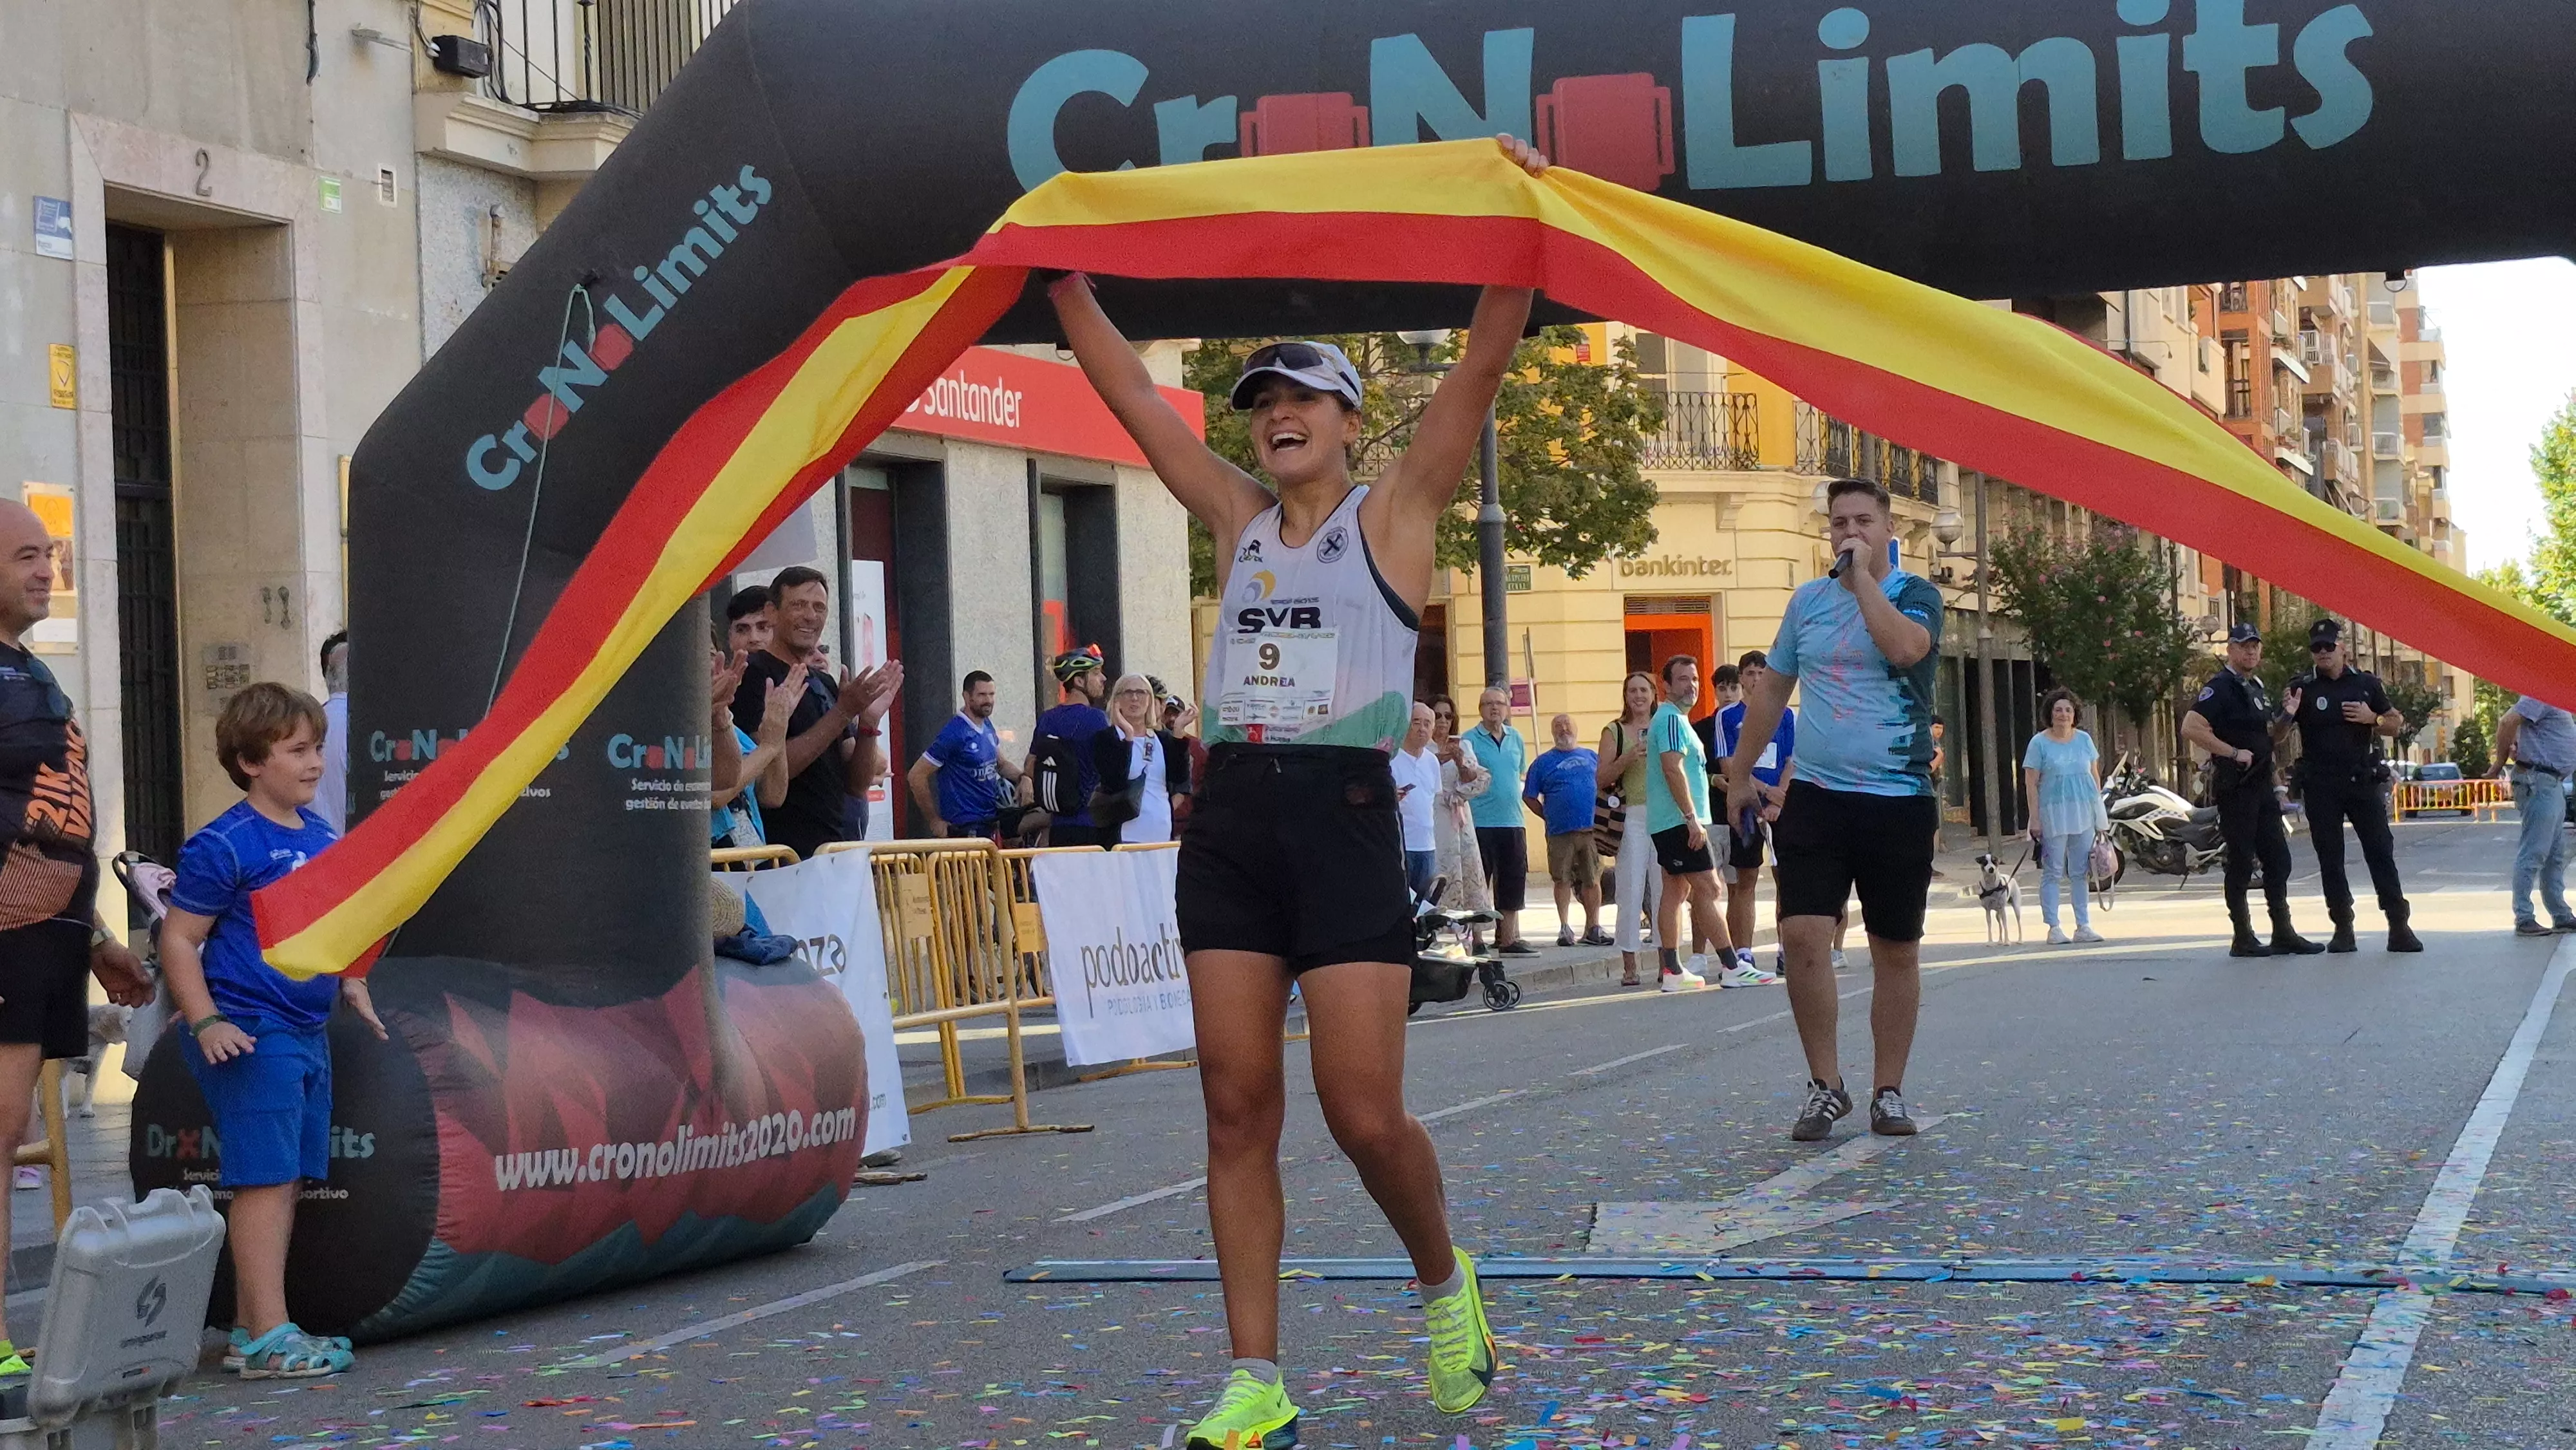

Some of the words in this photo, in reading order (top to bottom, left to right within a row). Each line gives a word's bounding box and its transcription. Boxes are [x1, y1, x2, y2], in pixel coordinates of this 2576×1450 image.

[194, 147, 213, 198] 2
[924, 368, 1023, 428] Santander
[1243, 675, 1296, 688] ANDREA
[1258, 643, 1281, 670] 9
[495, 1106, 856, 1191] www.cronolimits2020.com
